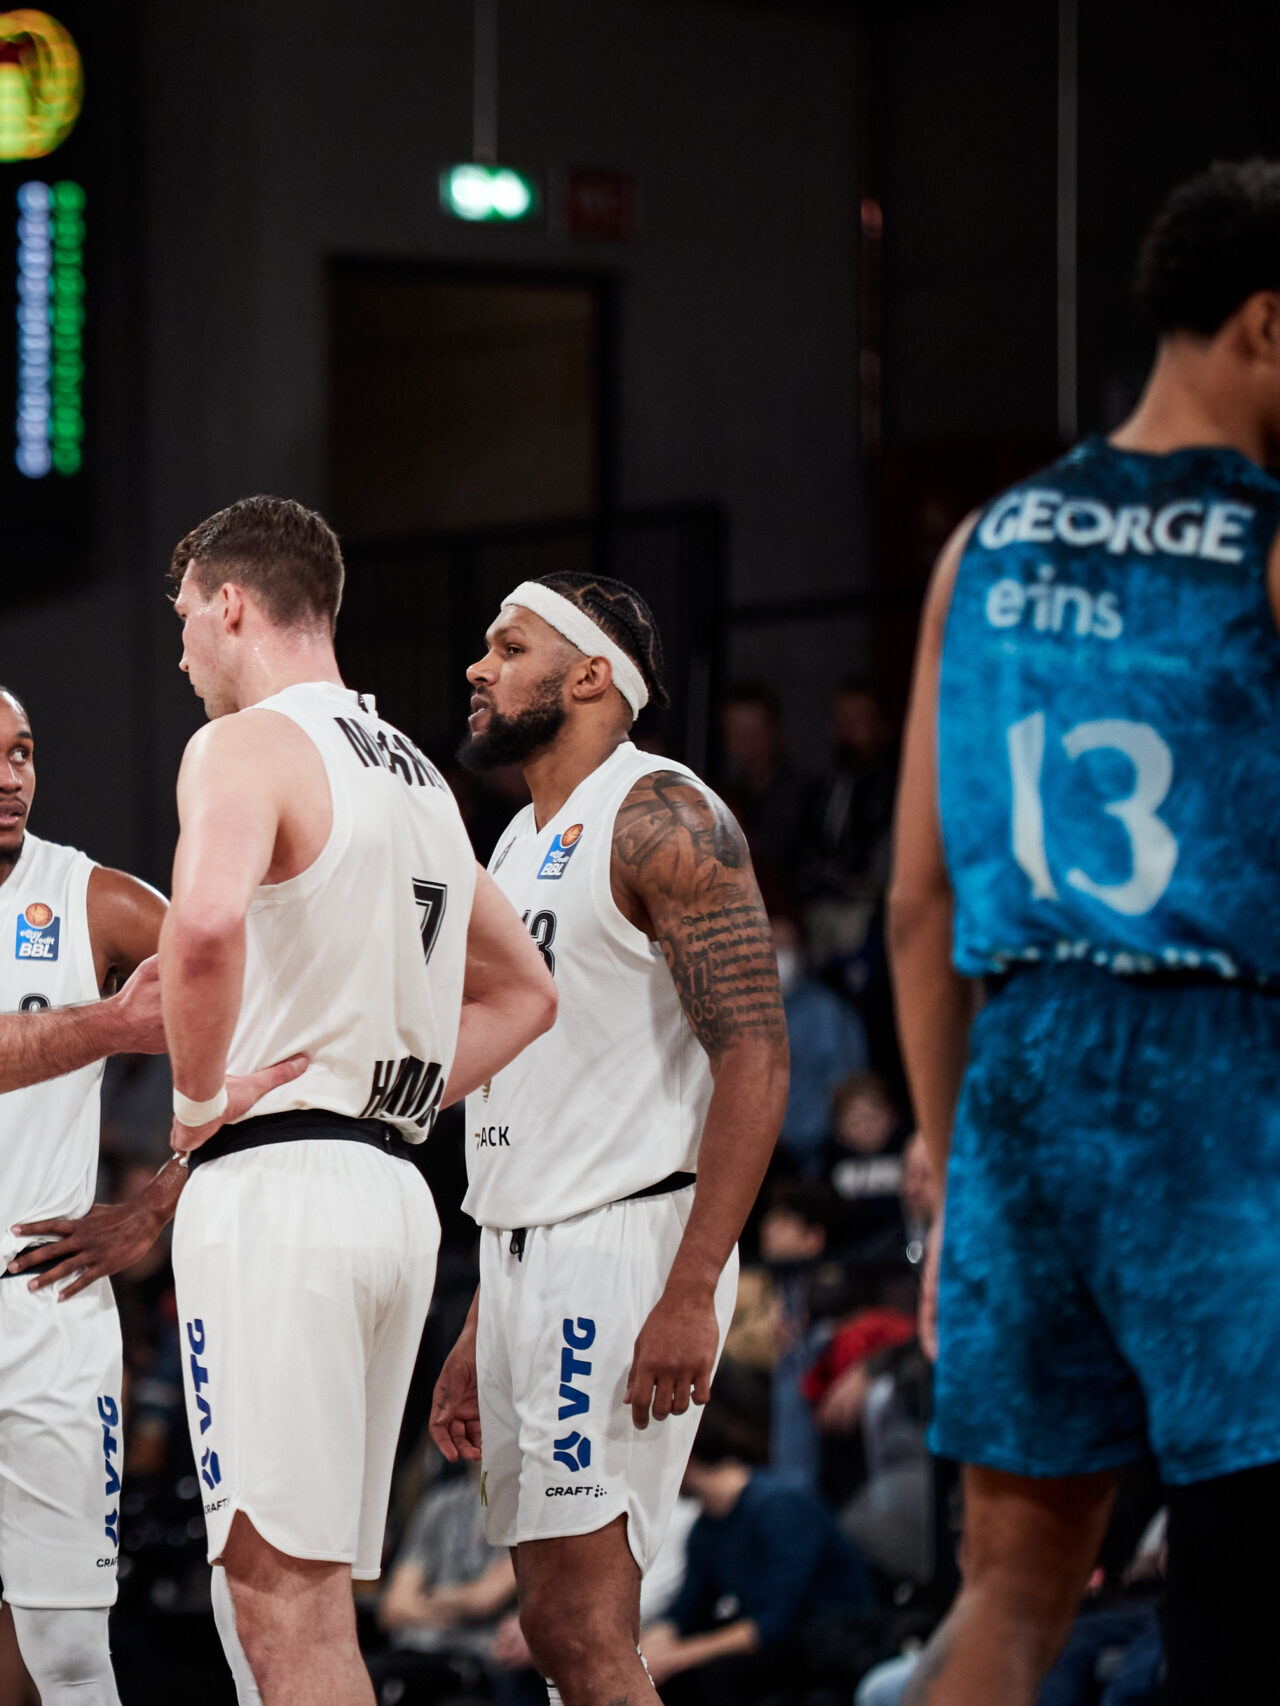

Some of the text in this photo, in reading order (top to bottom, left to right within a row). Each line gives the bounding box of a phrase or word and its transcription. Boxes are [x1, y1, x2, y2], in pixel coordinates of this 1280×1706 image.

[977, 489, 1254, 564] GEORGE
[985, 564, 1123, 640] eins
[1007, 710, 1179, 917] 13
[19, 942, 54, 958] BBL
[412, 877, 448, 966] 7
[480, 1126, 510, 1148] ACK
[187, 1318, 212, 1435] VTG
[558, 1317, 596, 1421] VTG
[97, 1395, 120, 1496] VTG
[545, 1486, 594, 1498] CRAFT
